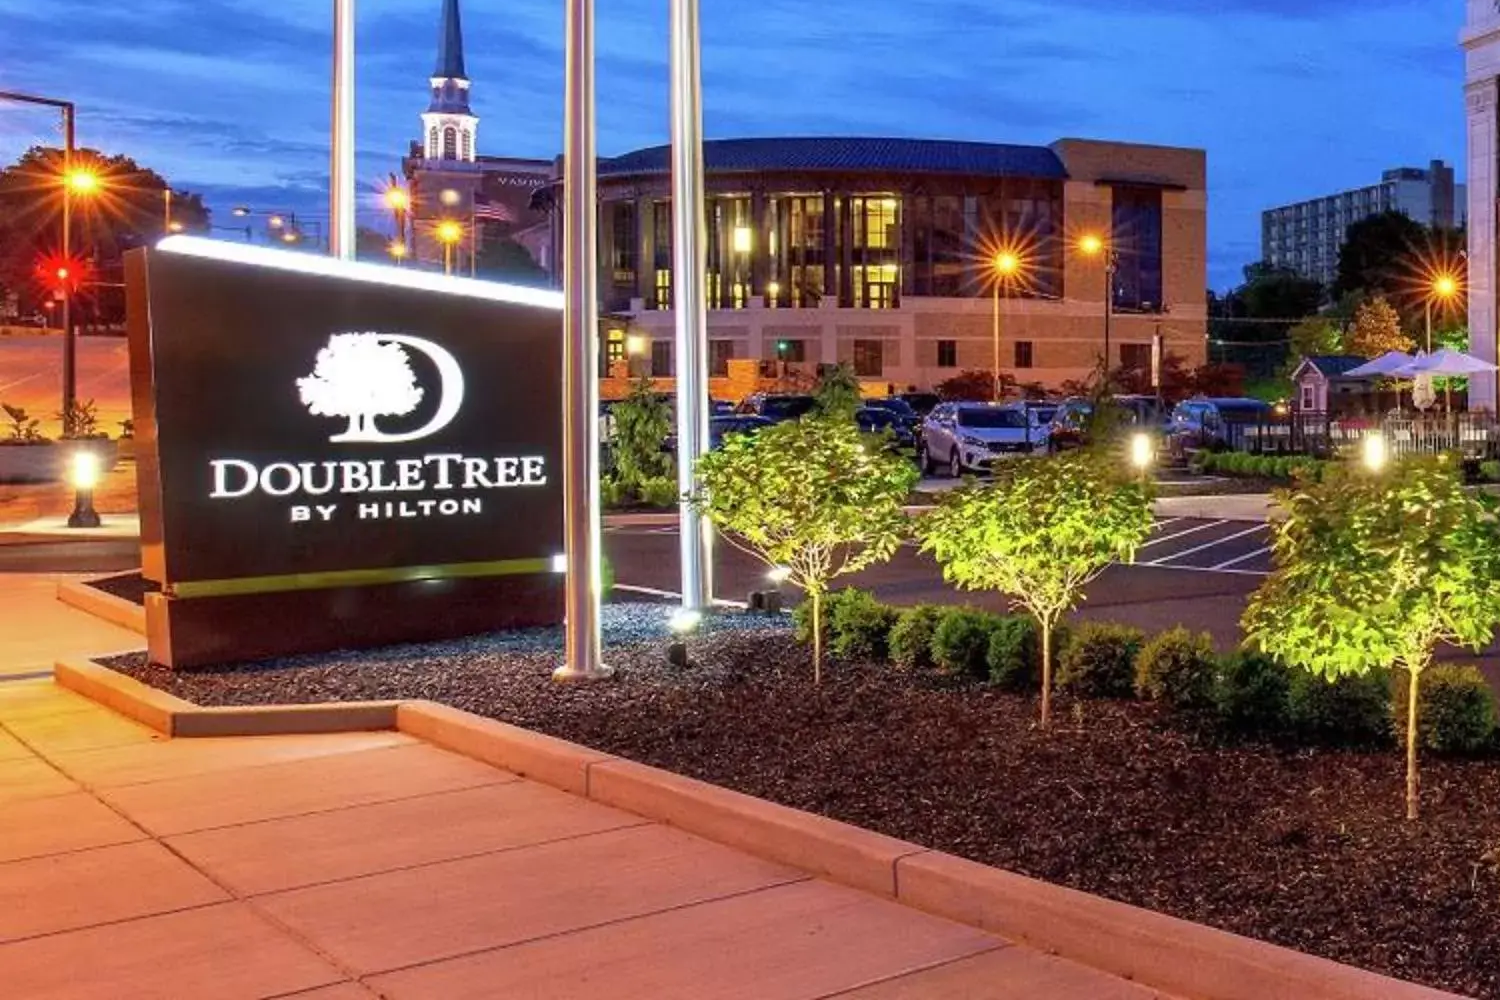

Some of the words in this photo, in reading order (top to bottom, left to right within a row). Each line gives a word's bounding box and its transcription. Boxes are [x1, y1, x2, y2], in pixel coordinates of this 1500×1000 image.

[208, 453, 547, 498] DOUBLETREE
[290, 504, 337, 522] BY
[358, 498, 482, 519] HILTON
